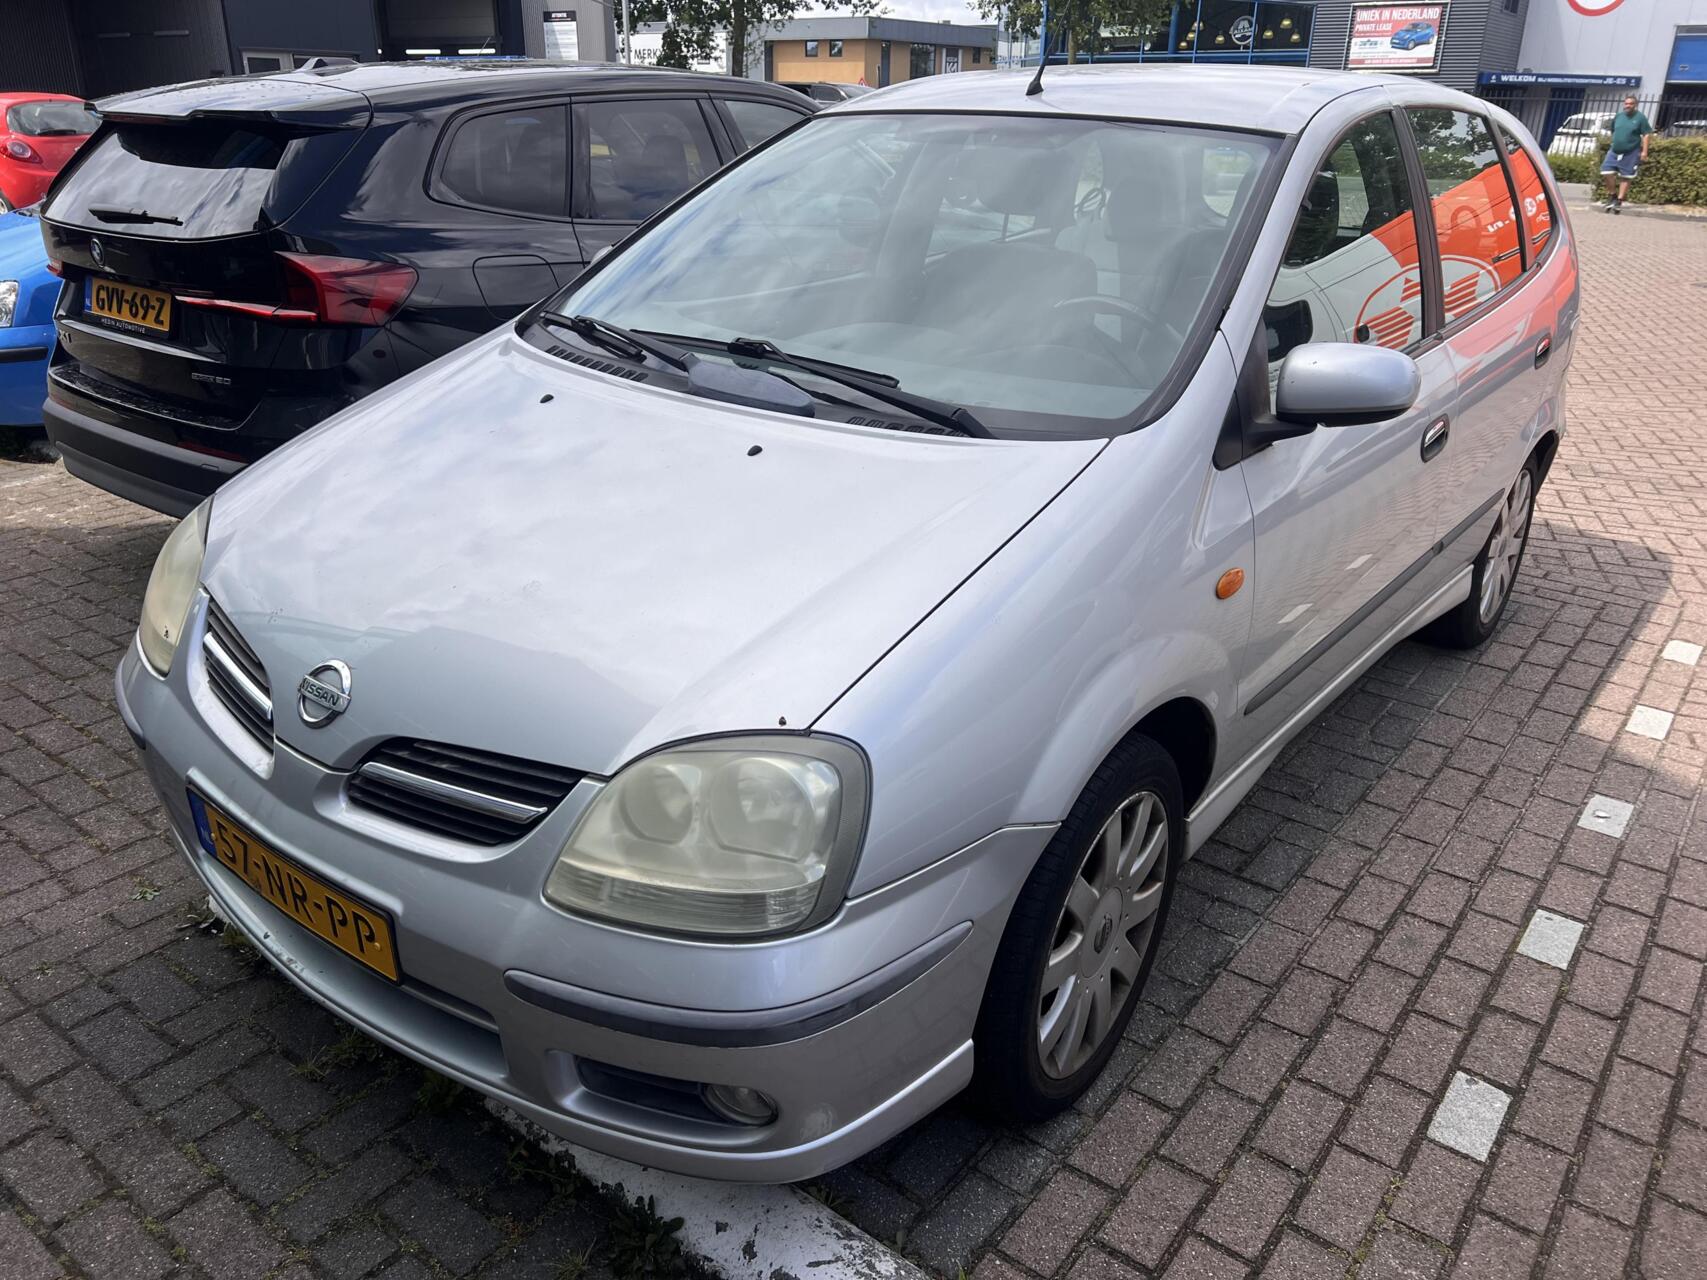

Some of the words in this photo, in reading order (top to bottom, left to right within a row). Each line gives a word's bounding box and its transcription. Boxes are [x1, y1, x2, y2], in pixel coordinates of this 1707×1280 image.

[1356, 9, 1382, 21] UNIEK
[1381, 9, 1391, 20] IN
[1391, 7, 1440, 20] NEDERLAND
[96, 284, 165, 326] GVV-69-Z
[300, 677, 340, 707] NISSAN
[215, 819, 376, 954] 57-NR-PP
